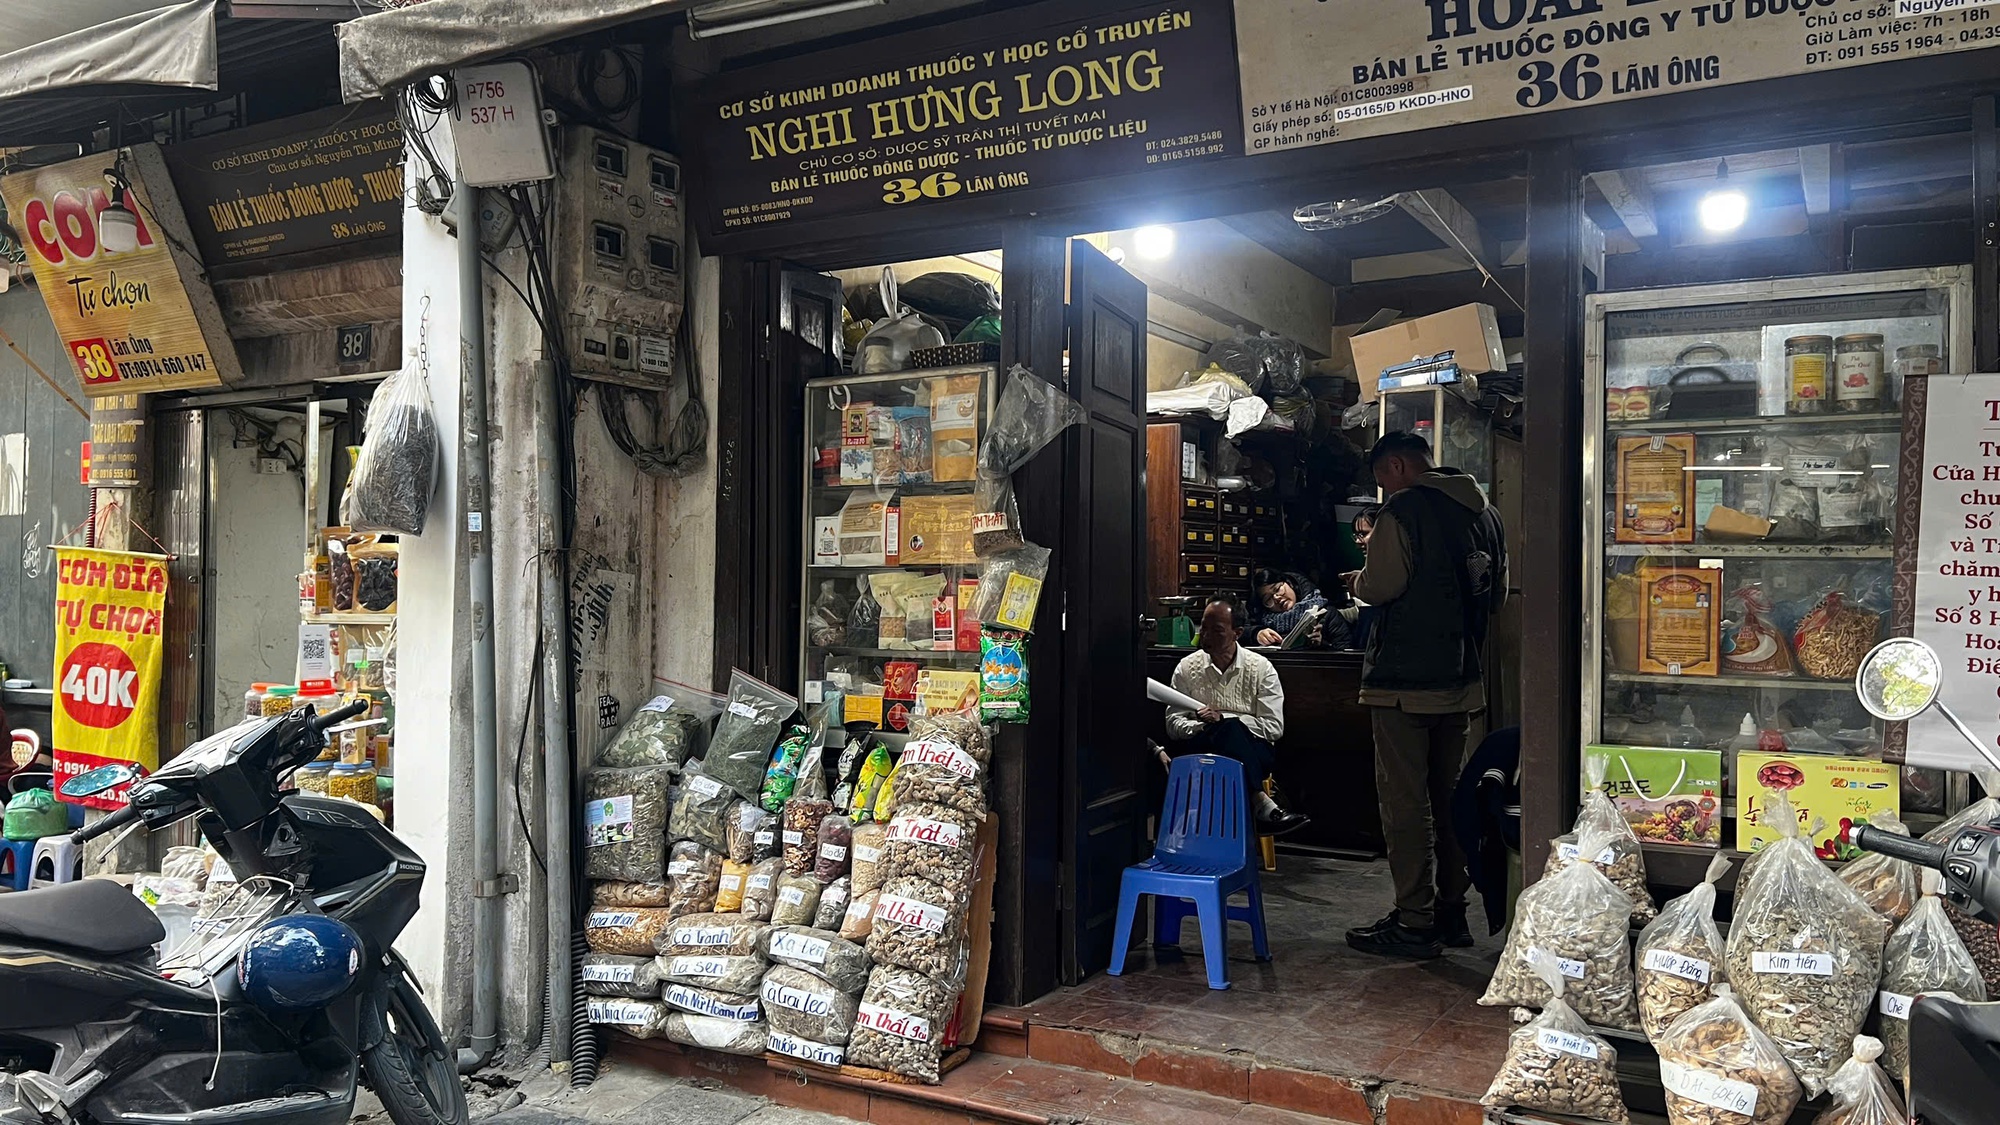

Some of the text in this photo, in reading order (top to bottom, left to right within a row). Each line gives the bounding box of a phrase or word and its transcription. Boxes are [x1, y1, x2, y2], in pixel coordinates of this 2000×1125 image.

[1805, 4, 1892, 28] Chủ cơ sở:
[1806, 31, 1833, 46] Giờ
[1839, 26, 1872, 42] Làm
[1878, 20, 1917, 34] việc:
[1922, 16, 1943, 28] 7h
[1961, 6, 1990, 22] 18h
[720, 9, 1192, 119] CƠ SỞ KINH DOANH THUỐC Y HỌC CỔ TRUYỀN
[1352, 10, 1681, 84] BÁN LẺ THUỐC ĐÔNG Y
[1806, 52, 1832, 64] ĐT:
[1838, 44, 1864, 60] 091
[1871, 40, 1900, 56] 555
[1904, 34, 1943, 50] 1964
[466, 81, 506, 100] P756
[1516, 53, 1720, 108] 36 LÃN ÔNG
[470, 105, 514, 124] 537 H
[746, 48, 1164, 160] NGHI HƯNG LONG
[1252, 82, 1414, 118] Sở Y tế Hà Nội: 01C8003998
[1252, 88, 1470, 134] Giấy phép số: 05-0165/Đ KKDD-HNO
[212, 159, 226, 171] CƠ
[242, 150, 270, 164] KINH
[350, 130, 360, 140] Y
[354, 142, 372, 156] Thị
[800, 109, 1106, 170] CHỦ CƠ SỞ: DƯỢC SỸ TRẦN THỊ TUYẾT MAI
[1254, 125, 1340, 150] GP hành nghề:
[770, 177, 800, 194] BÁN
[804, 170, 819, 188] LẺ
[823, 164, 868, 184] THUỐC
[872, 159, 914, 176] ĐÔNG
[918, 151, 959, 170] DƯỢC
[975, 137, 1026, 160] THUỐC
[1032, 134, 1053, 150] TỪ
[1058, 126, 1103, 147] DƯỢC
[1109, 119, 1147, 138] LIỆU
[208, 198, 236, 232] BÁN
[248, 182, 290, 224] THUỐC
[286, 182, 325, 218] ĐÔNG
[320, 176, 359, 214] DƯỢC
[882, 171, 1028, 204] 36 LÃN ÔNG
[331, 222, 350, 239] 38
[366, 220, 386, 232] ÔNG
[66, 270, 150, 318] Tự chọn
[76, 343, 114, 380] 38
[132, 334, 154, 354] Ông
[342, 332, 362, 357] 38
[164, 356, 185, 372] 660
[184, 354, 206, 372] 147
[1932, 464, 1975, 481] Cửa
[1964, 511, 1994, 530] Số
[1950, 537, 1974, 552] và
[58, 558, 164, 594] CƠM ĐĨA
[1936, 606, 1982, 625] Số 8
[1969, 590, 1982, 606] y
[56, 598, 161, 642] TỰ CHỌN
[61, 664, 137, 710] 40K
